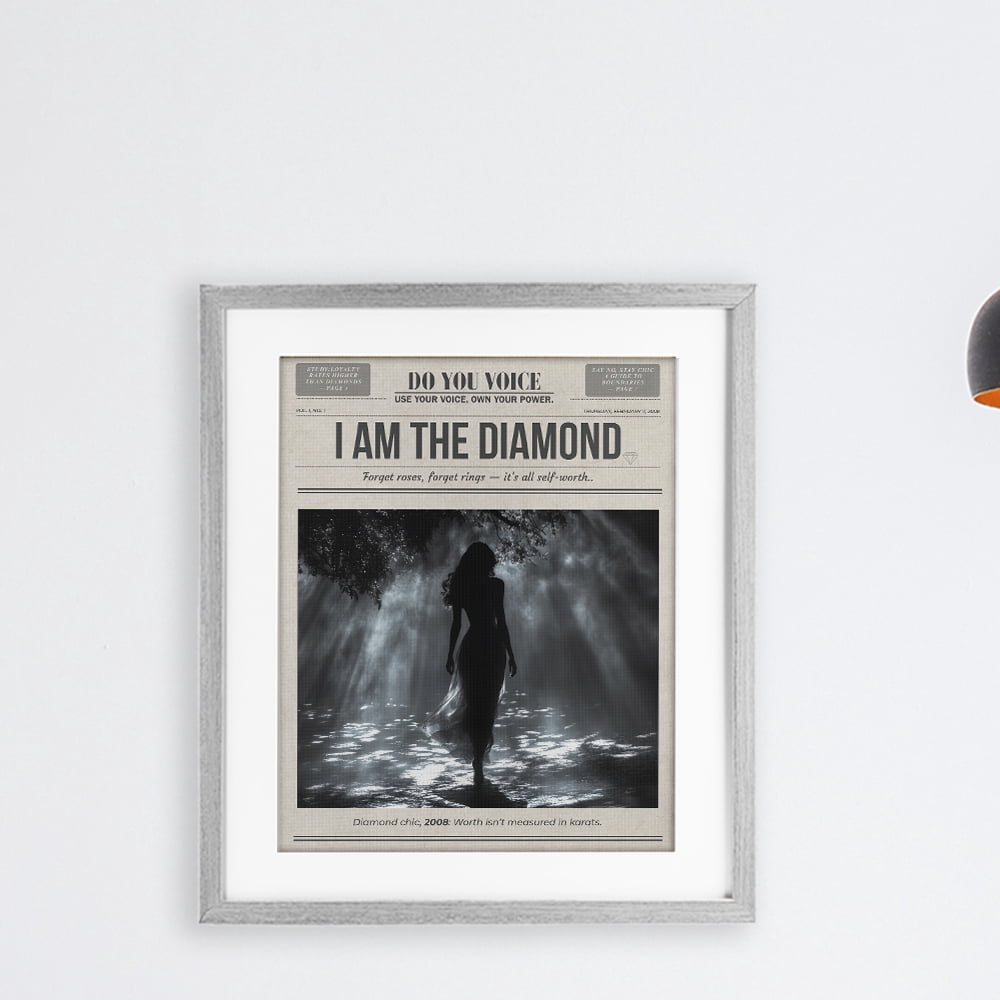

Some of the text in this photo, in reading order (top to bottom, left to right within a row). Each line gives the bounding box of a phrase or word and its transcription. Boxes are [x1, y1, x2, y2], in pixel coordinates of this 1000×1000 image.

[408, 371, 541, 390] DO YOU VOICE
[394, 395, 554, 404] USE YOUR VOICE. OWN YOUR POWER.
[335, 421, 622, 460] I AM THE DIAMOND
[362, 471, 394, 484] Forget
[396, 474, 424, 483] roses,
[427, 471, 459, 484] forget
[460, 472, 486, 484] rings
[503, 471, 519, 482] it's
[521, 471, 535, 482] all
[352, 818, 398, 826] Diamond
[399, 818, 422, 828] chic,
[453, 818, 483, 826] Worth
[485, 818, 505, 826] isn't
[507, 818, 556, 826] measured
[557, 818, 567, 826] in
[569, 818, 602, 826] karats.
